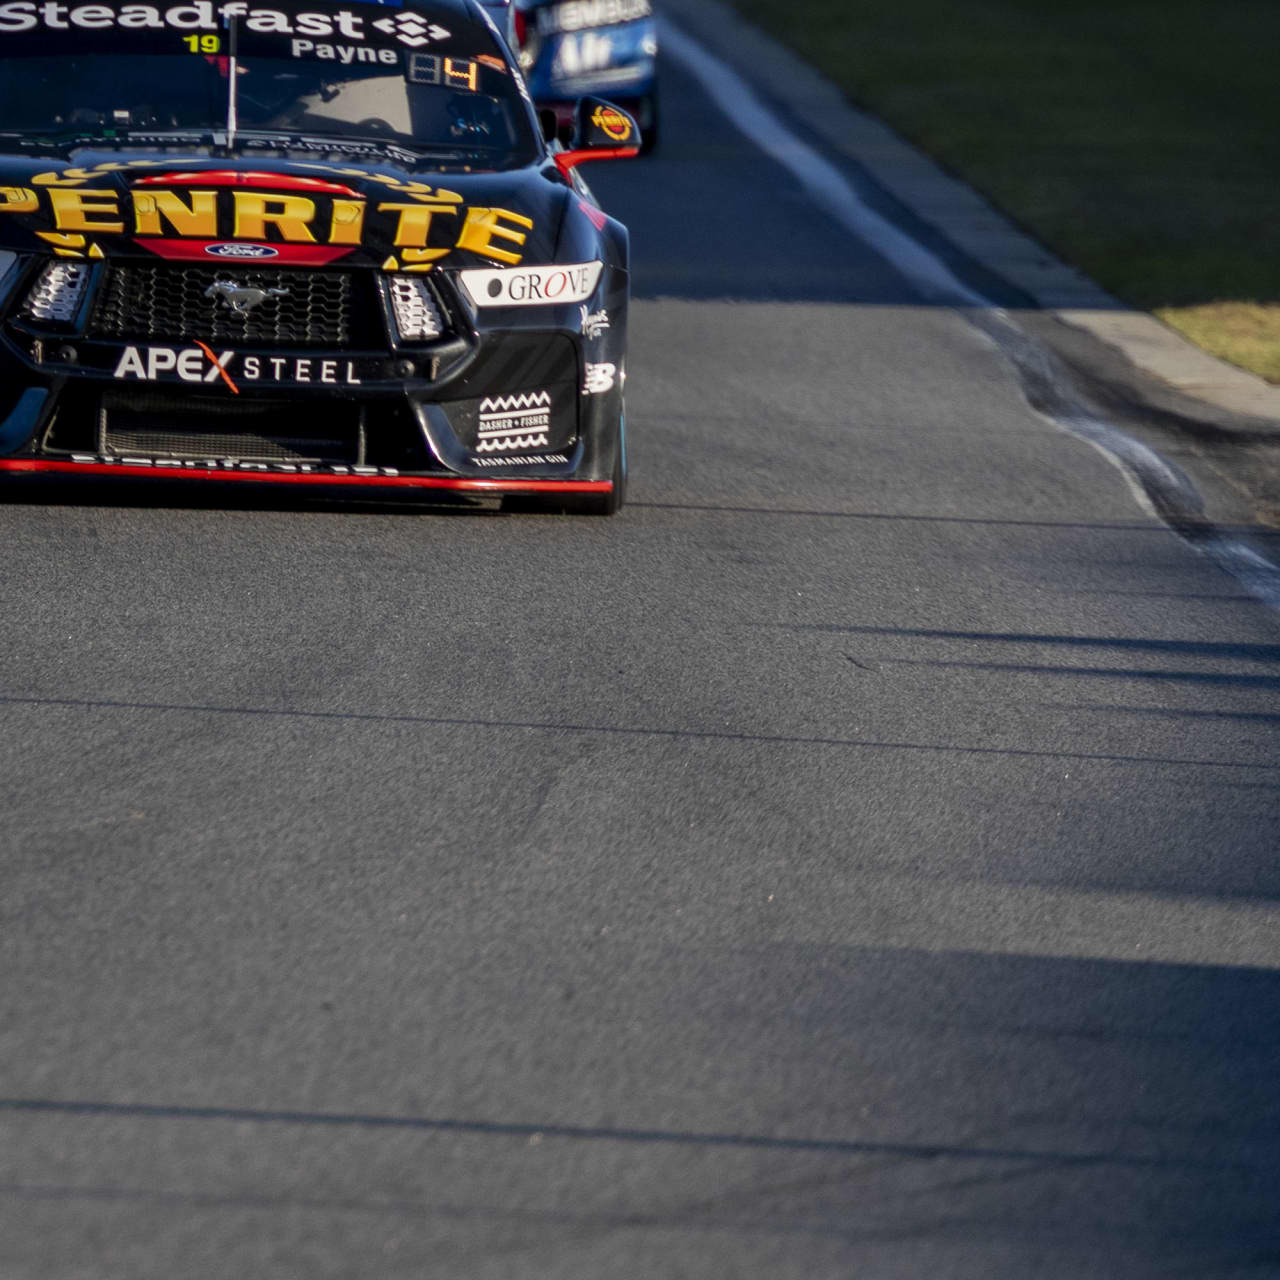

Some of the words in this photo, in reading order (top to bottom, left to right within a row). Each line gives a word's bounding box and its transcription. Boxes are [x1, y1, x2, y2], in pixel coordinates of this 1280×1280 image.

[182, 34, 221, 54] 19
[291, 38, 399, 64] Payne
[508, 267, 589, 301] GROVE
[113, 339, 238, 394] APEX
[243, 356, 362, 385] STEEL
[479, 418, 513, 431] DASHER
[519, 414, 550, 428] FISHER
[471, 455, 546, 468] TASMANIAN
[545, 454, 569, 464] GIN
